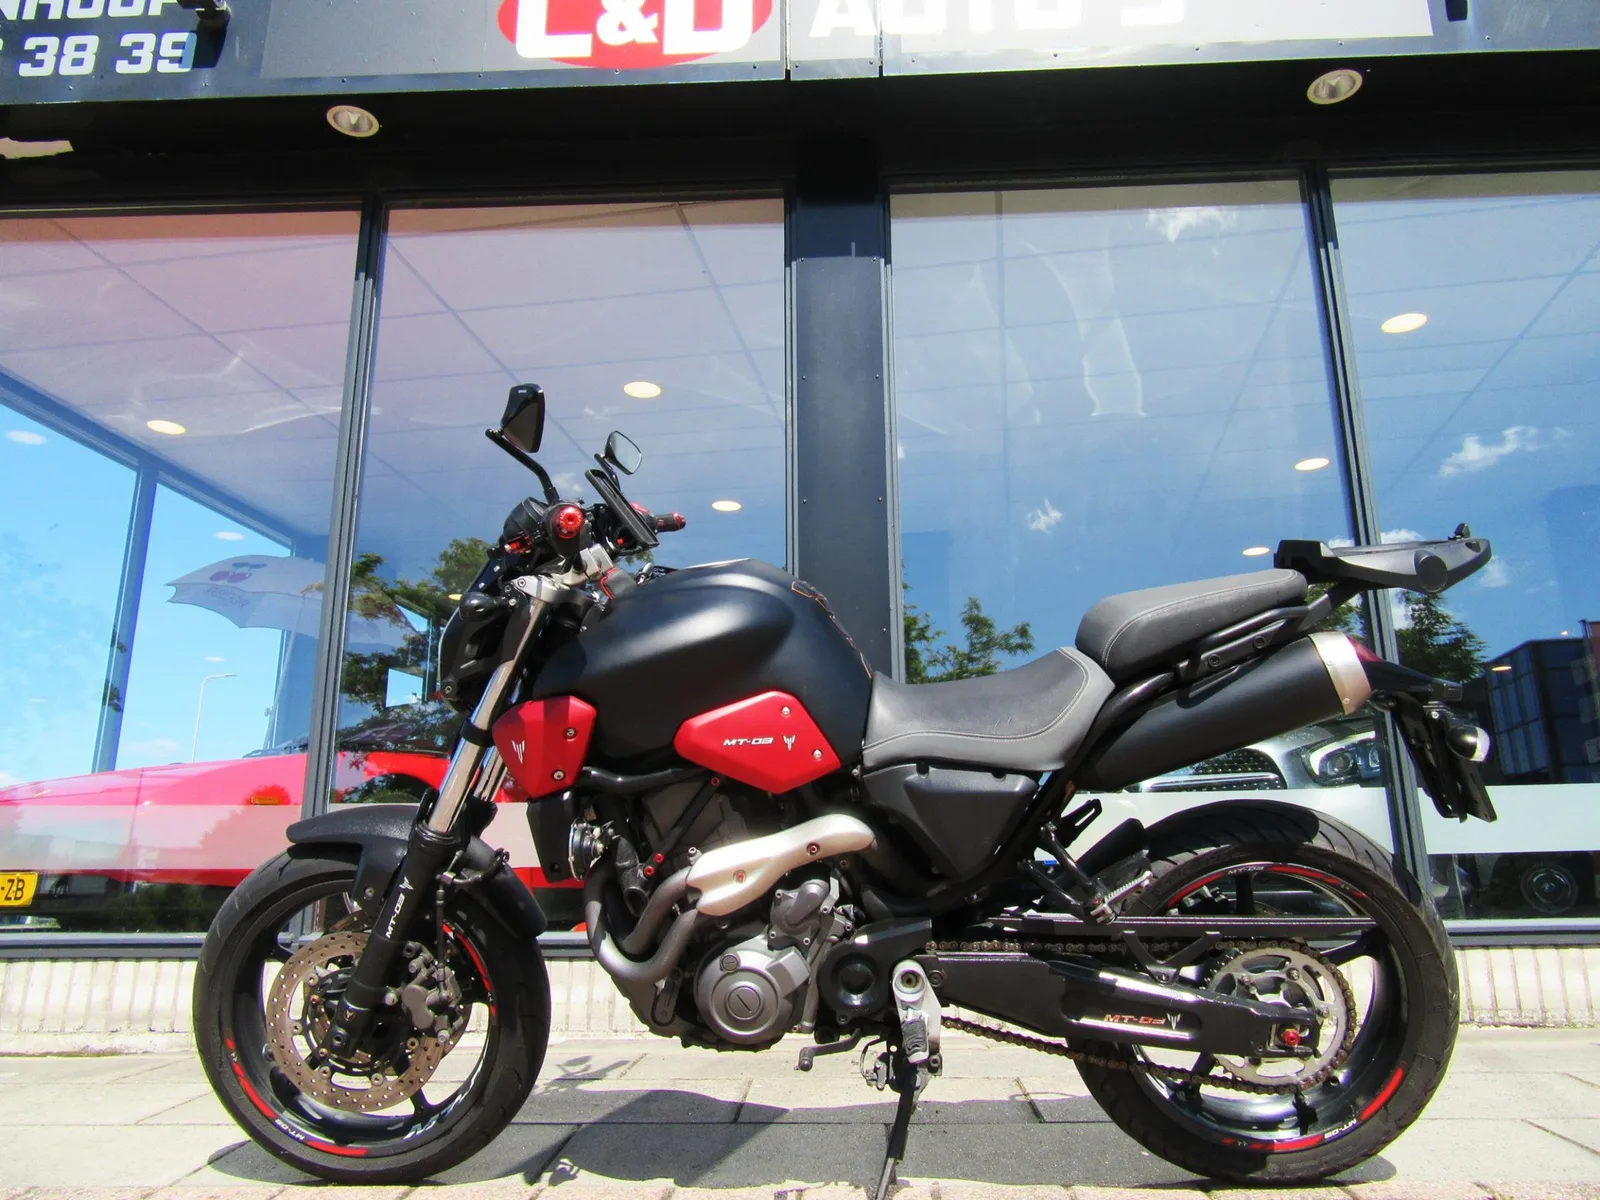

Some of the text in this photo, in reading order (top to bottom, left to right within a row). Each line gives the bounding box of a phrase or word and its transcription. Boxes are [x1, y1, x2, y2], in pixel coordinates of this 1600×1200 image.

[18, 32, 197, 77] 38 39
[722, 736, 774, 746] MT-03
[1103, 1013, 1167, 1025] MT-03
